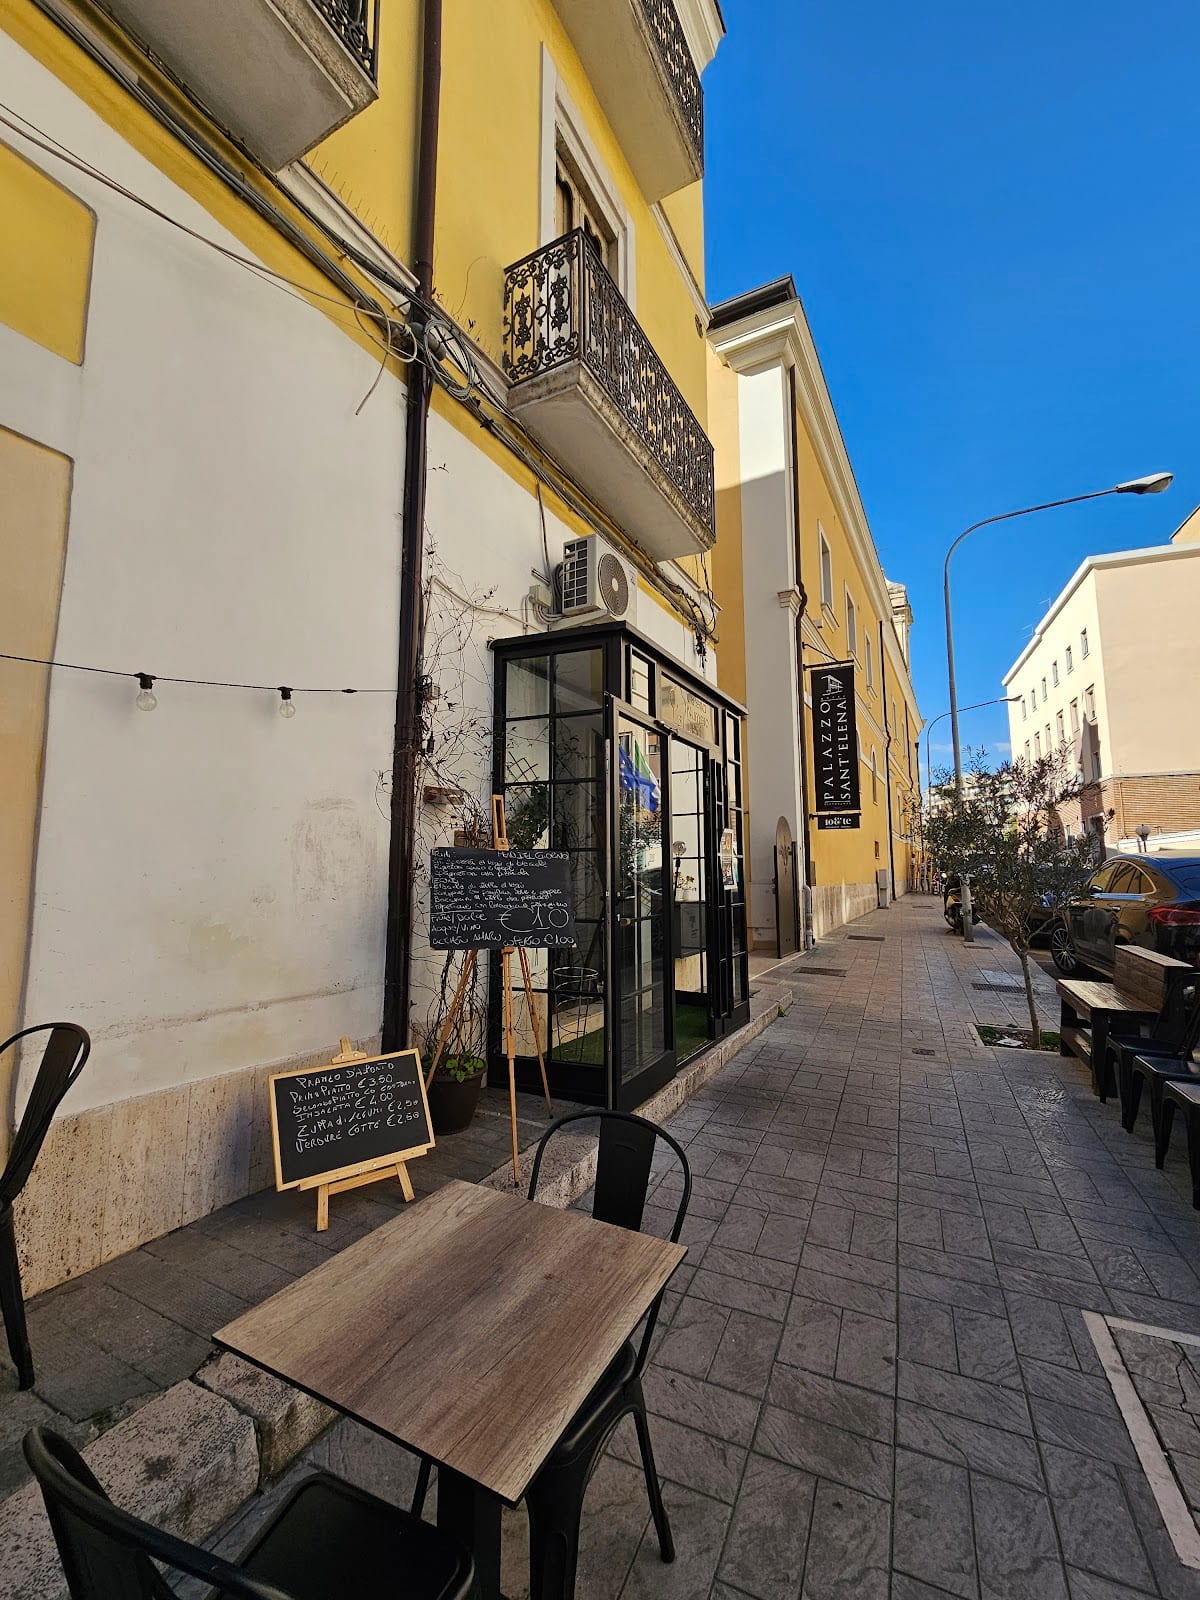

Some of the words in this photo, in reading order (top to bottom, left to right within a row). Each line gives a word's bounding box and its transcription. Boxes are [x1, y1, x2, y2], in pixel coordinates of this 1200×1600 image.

[819, 701, 835, 800] PALAZZO
[836, 700, 851, 800] SANT'ELENA
[320, 1084, 351, 1096] PIATTO
[297, 1119, 334, 1137] ZUPPA
